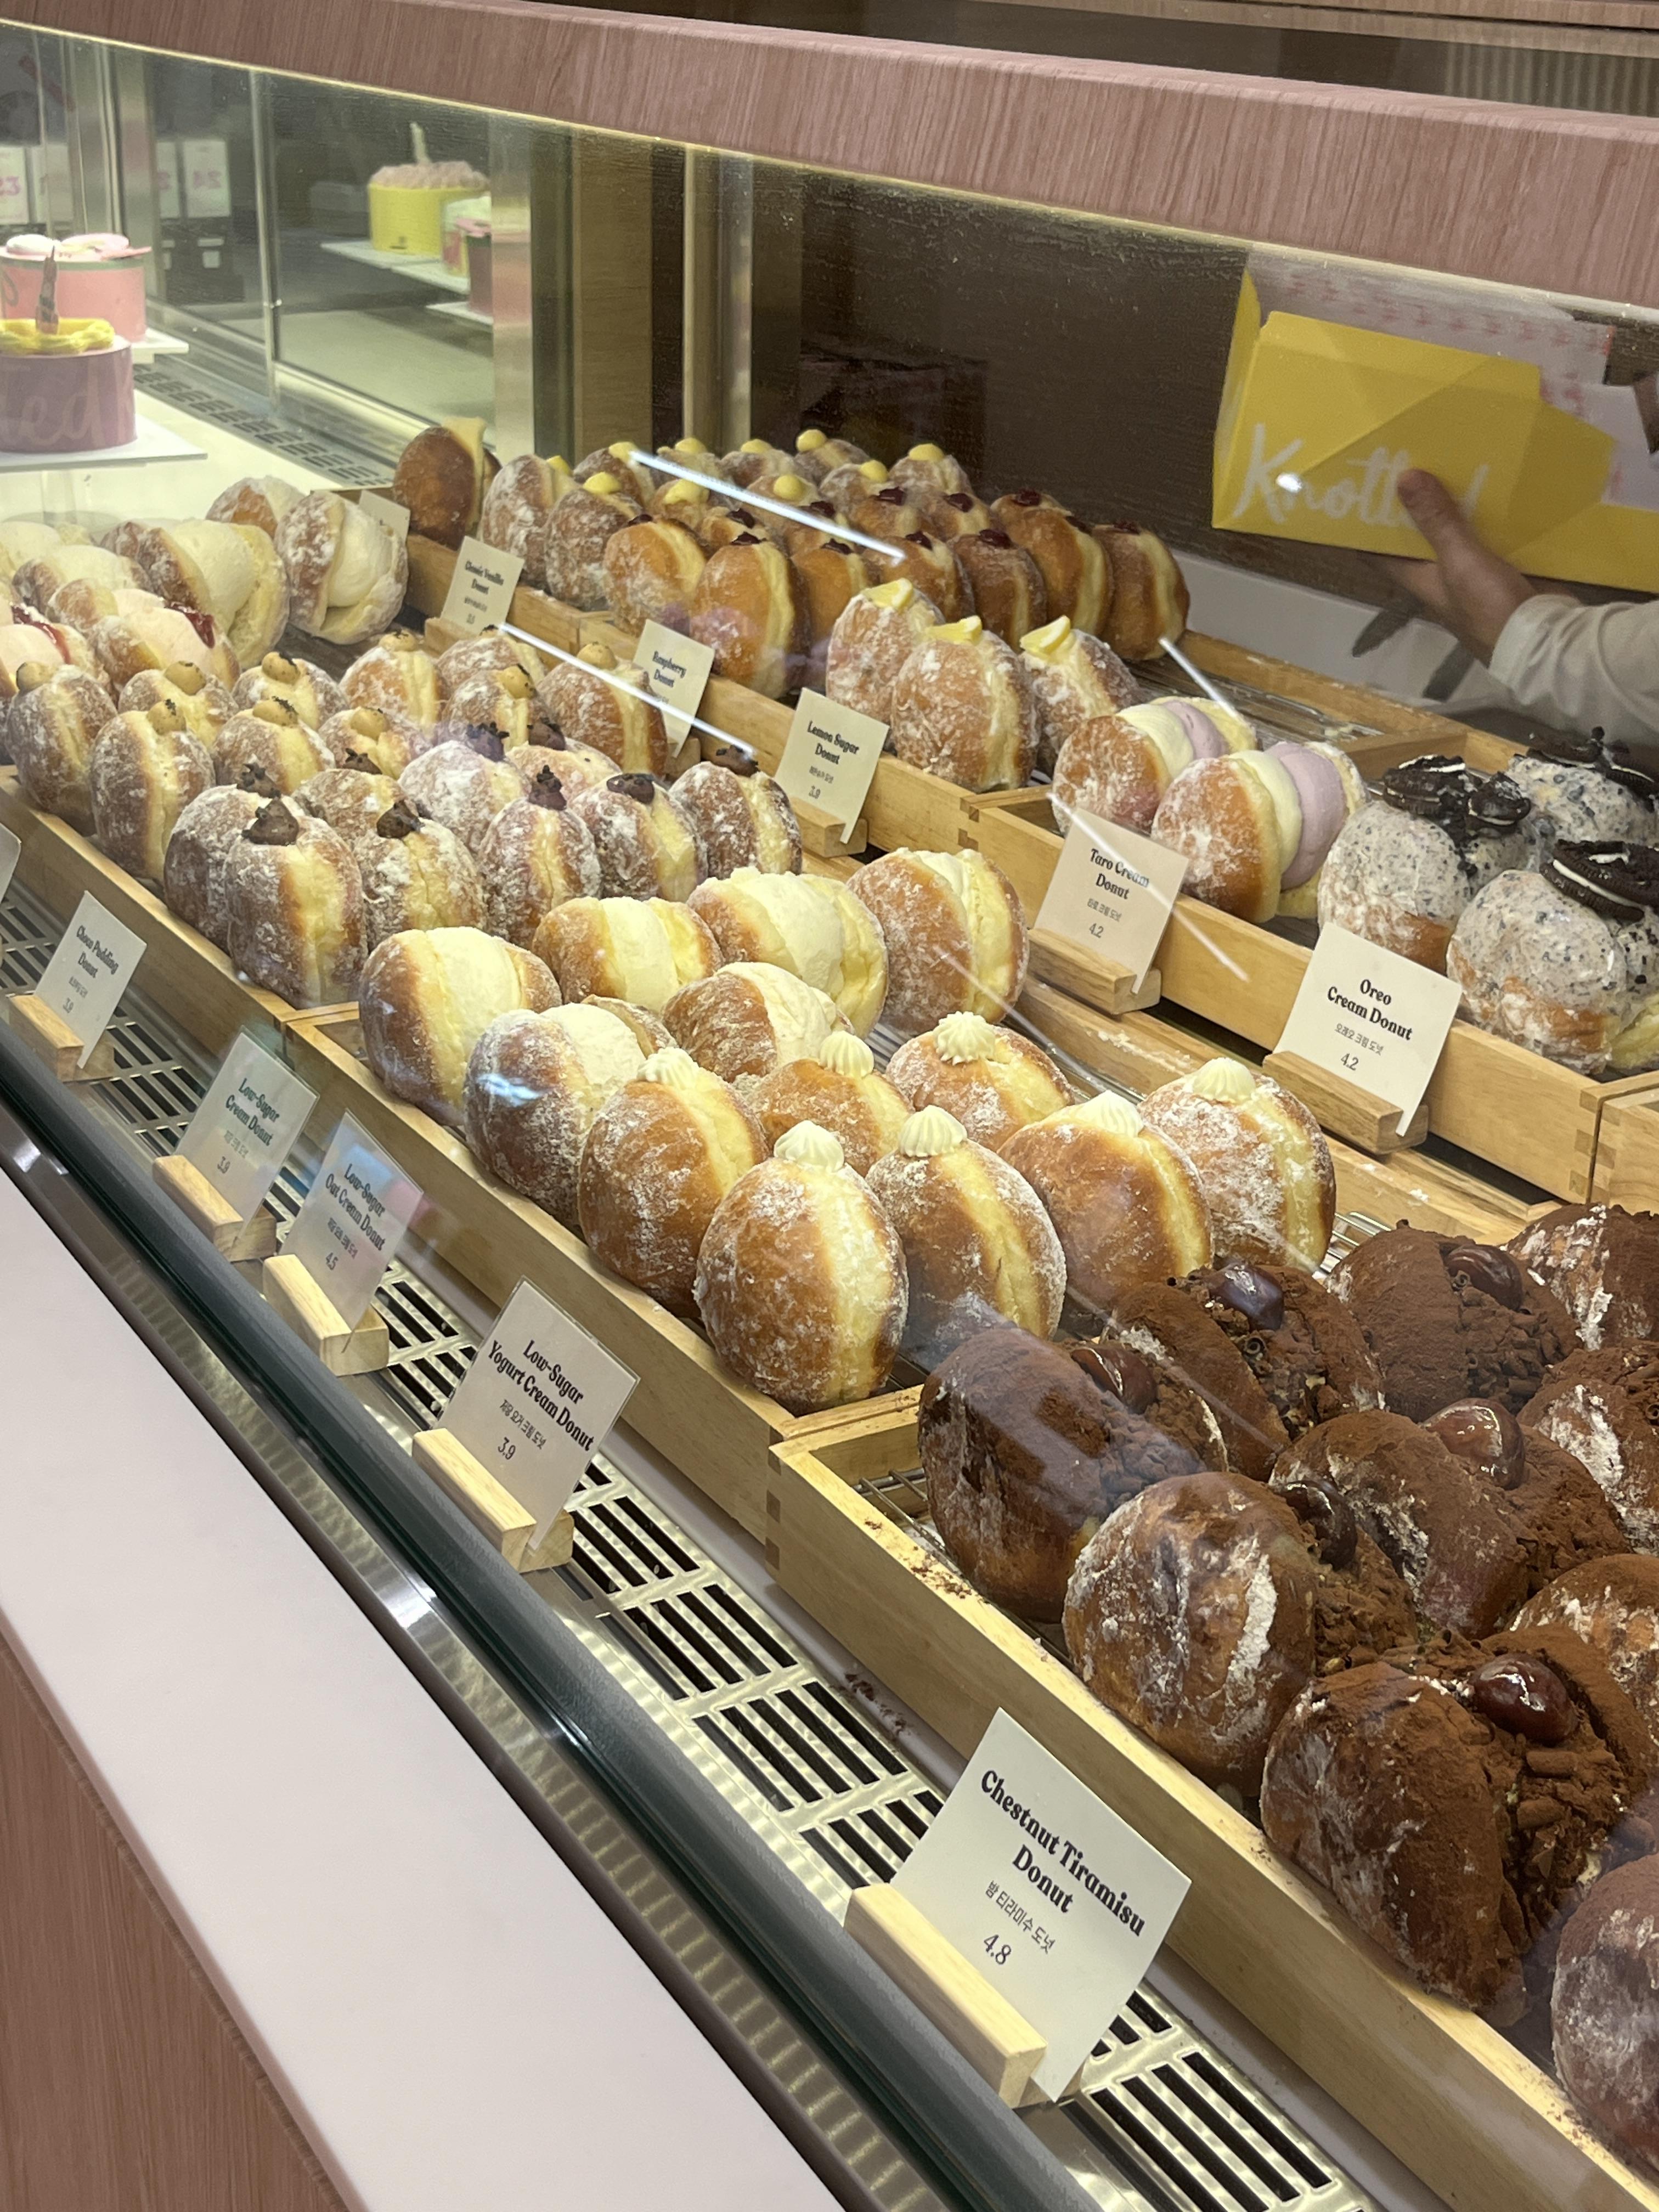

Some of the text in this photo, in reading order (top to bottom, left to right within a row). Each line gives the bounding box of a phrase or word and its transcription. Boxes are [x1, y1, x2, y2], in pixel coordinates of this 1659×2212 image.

[652, 650, 687, 679] Raspberry
[653, 669, 674, 688] Donut
[807, 720, 859, 754] Lemon Sugar
[815, 743, 840, 765] Donut
[1090, 848, 1149, 888] Taro Cream
[1096, 873, 1130, 900] Donut
[1098, 904, 1110, 916] 크림
[1109, 909, 1122, 922] 도넛
[1089, 923, 1104, 939] 4.2
[76, 925, 119, 975] Choco Pudding
[78, 951, 98, 978] Donut
[1359, 979, 1392, 1005] Oreo
[1328, 986, 1413, 1041] Cream Donut
[1334, 1023, 1384, 1056] 오레오 크림 도넛
[1341, 1053, 1359, 1071] 4.2
[239, 1077, 280, 1123] Low-Sugar
[225, 1094, 274, 1146] Cream Donut
[344, 1163, 386, 1217] Low-Sugar
[326, 1173, 386, 1251] Oat Cream Donut
[325, 1252, 338, 1271] 4.5
[523, 1339, 584, 1404] Low-Sugar
[488, 1340, 594, 1451] Yogurt Cream Donut
[498, 1436, 516, 1460] 3.9
[521, 1420, 536, 1438] 크림
[532, 1431, 548, 1450] 도넛
[981, 1769, 1146, 1937] Chestnut Tiramisu
[1012, 1844, 1074, 1913] Donut
[985, 1880, 1056, 1954] 밤 티라미수 도넛
[984, 1934, 1012, 1965] 4.8
